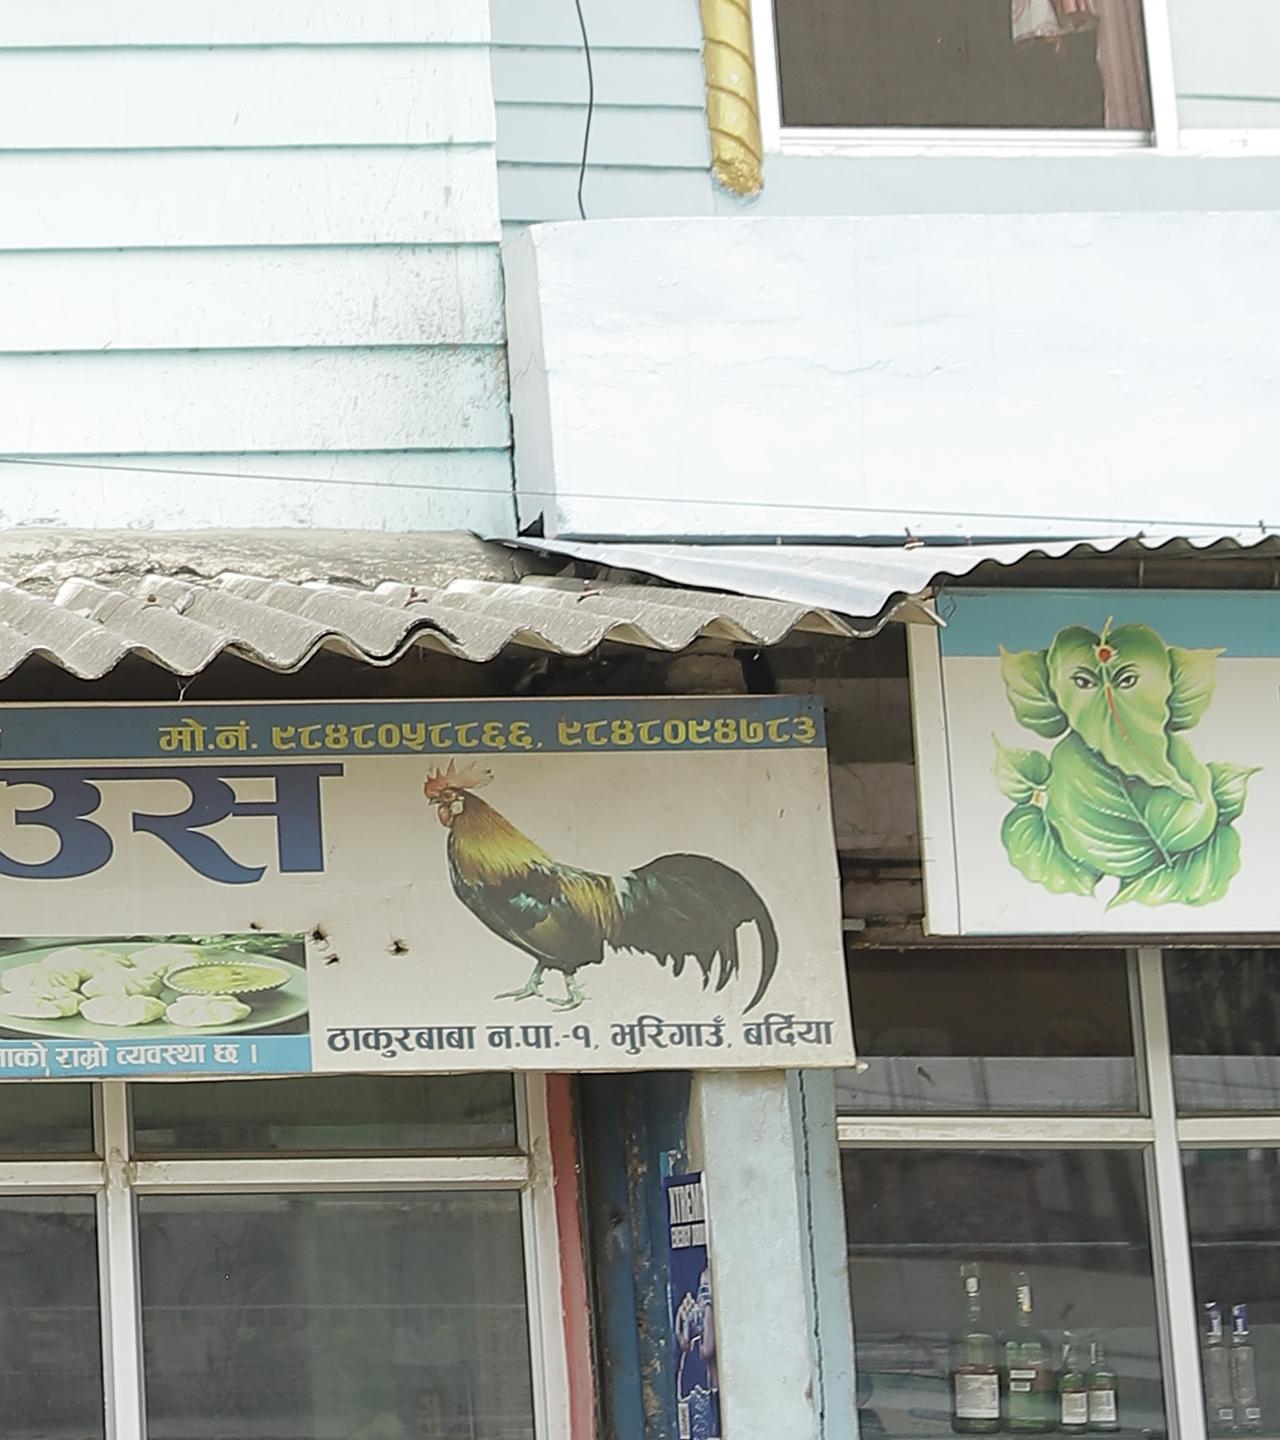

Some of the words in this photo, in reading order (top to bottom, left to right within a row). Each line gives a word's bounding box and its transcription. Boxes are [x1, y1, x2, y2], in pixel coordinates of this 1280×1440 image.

[558, 717, 815, 745] ९८४८०९४७८३
[327, 1026, 476, 1058] ठाकुरबाबा
[742, 1013, 834, 1047] बर्दिया
[55, 1042, 109, 1070] राम्रो
[116, 1044, 209, 1074] व्यवस्था
[213, 1044, 240, 1073] छ
[668, 1186, 705, 1226] XTREM
